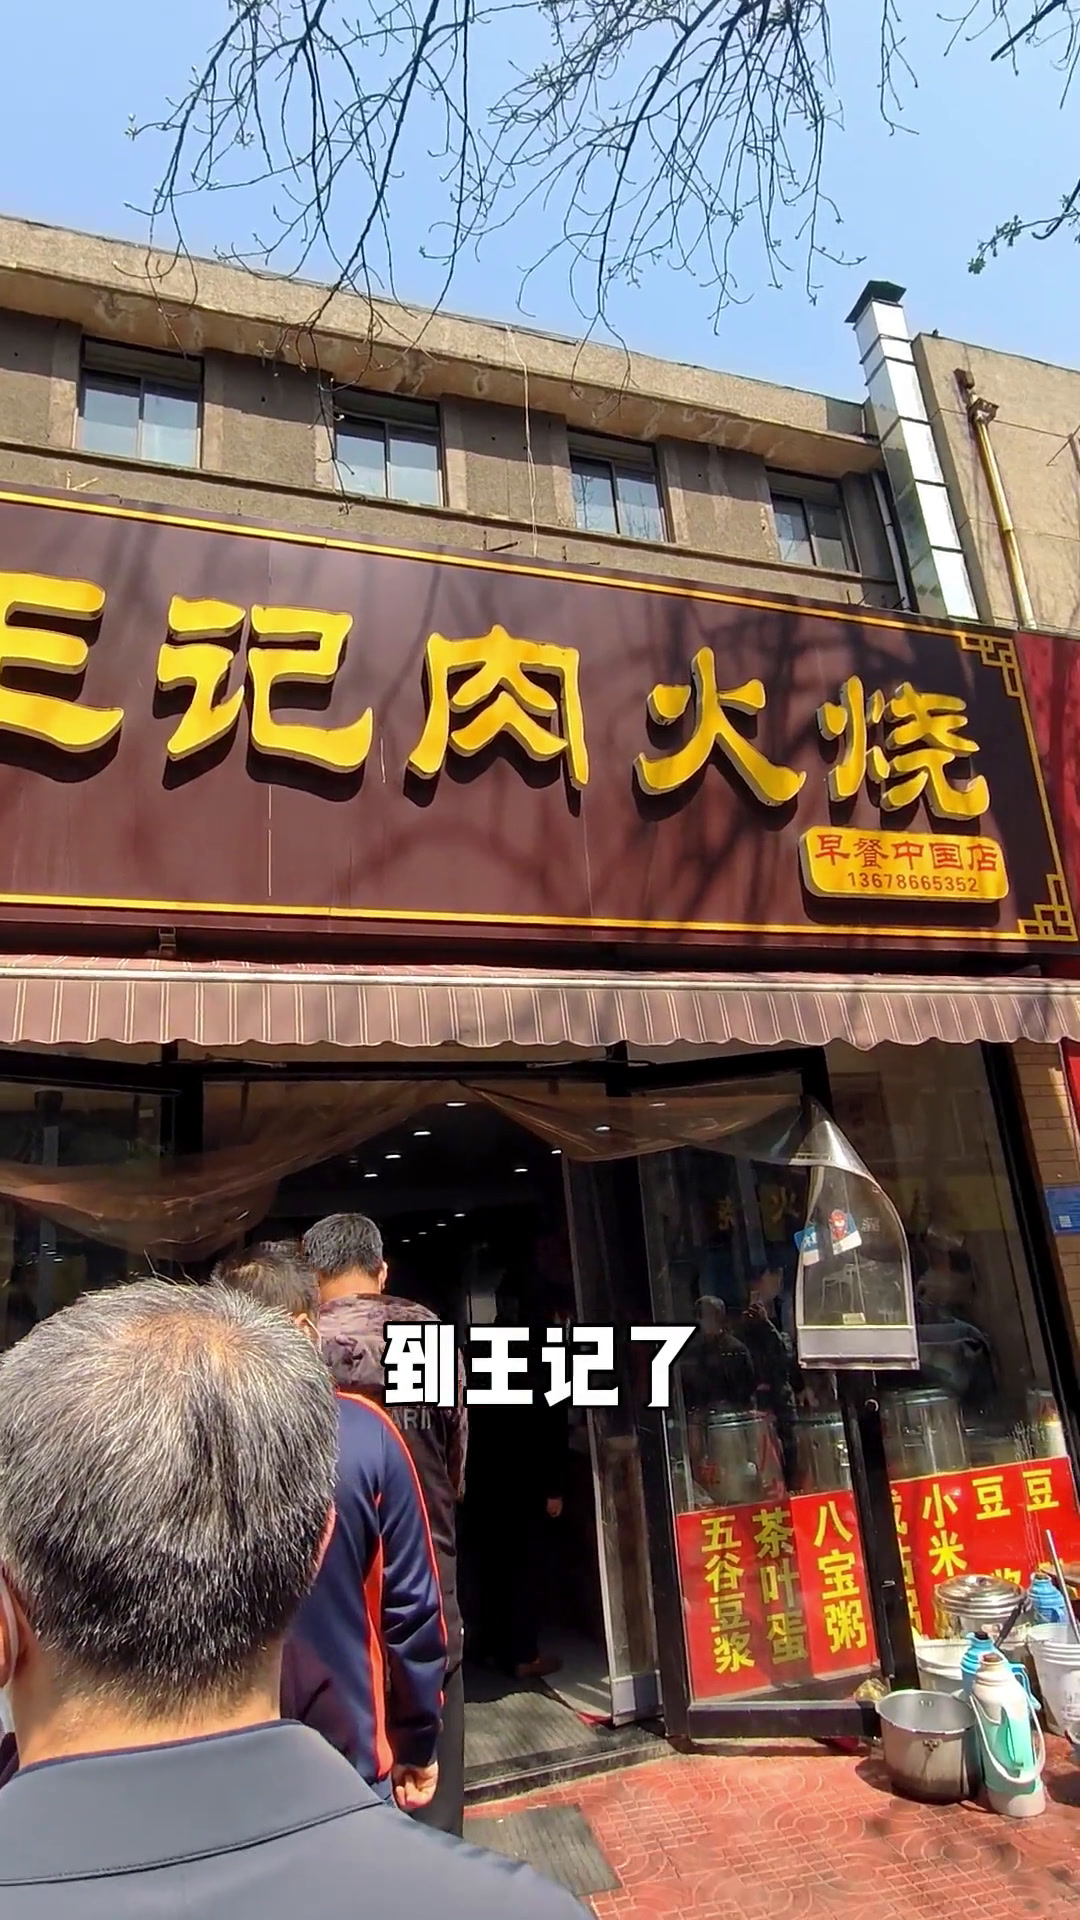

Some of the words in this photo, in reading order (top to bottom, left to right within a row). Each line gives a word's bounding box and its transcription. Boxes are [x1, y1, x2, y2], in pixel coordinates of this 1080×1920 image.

[815, 834, 998, 872] 早餐中国店
[848, 871, 978, 893] 13678665352
[701, 1515, 755, 1674] 五谷豆浆
[752, 1507, 808, 1665] 茶叶蛋
[813, 1501, 867, 1654] 八宝粥
[922, 1483, 968, 1637] 小米
